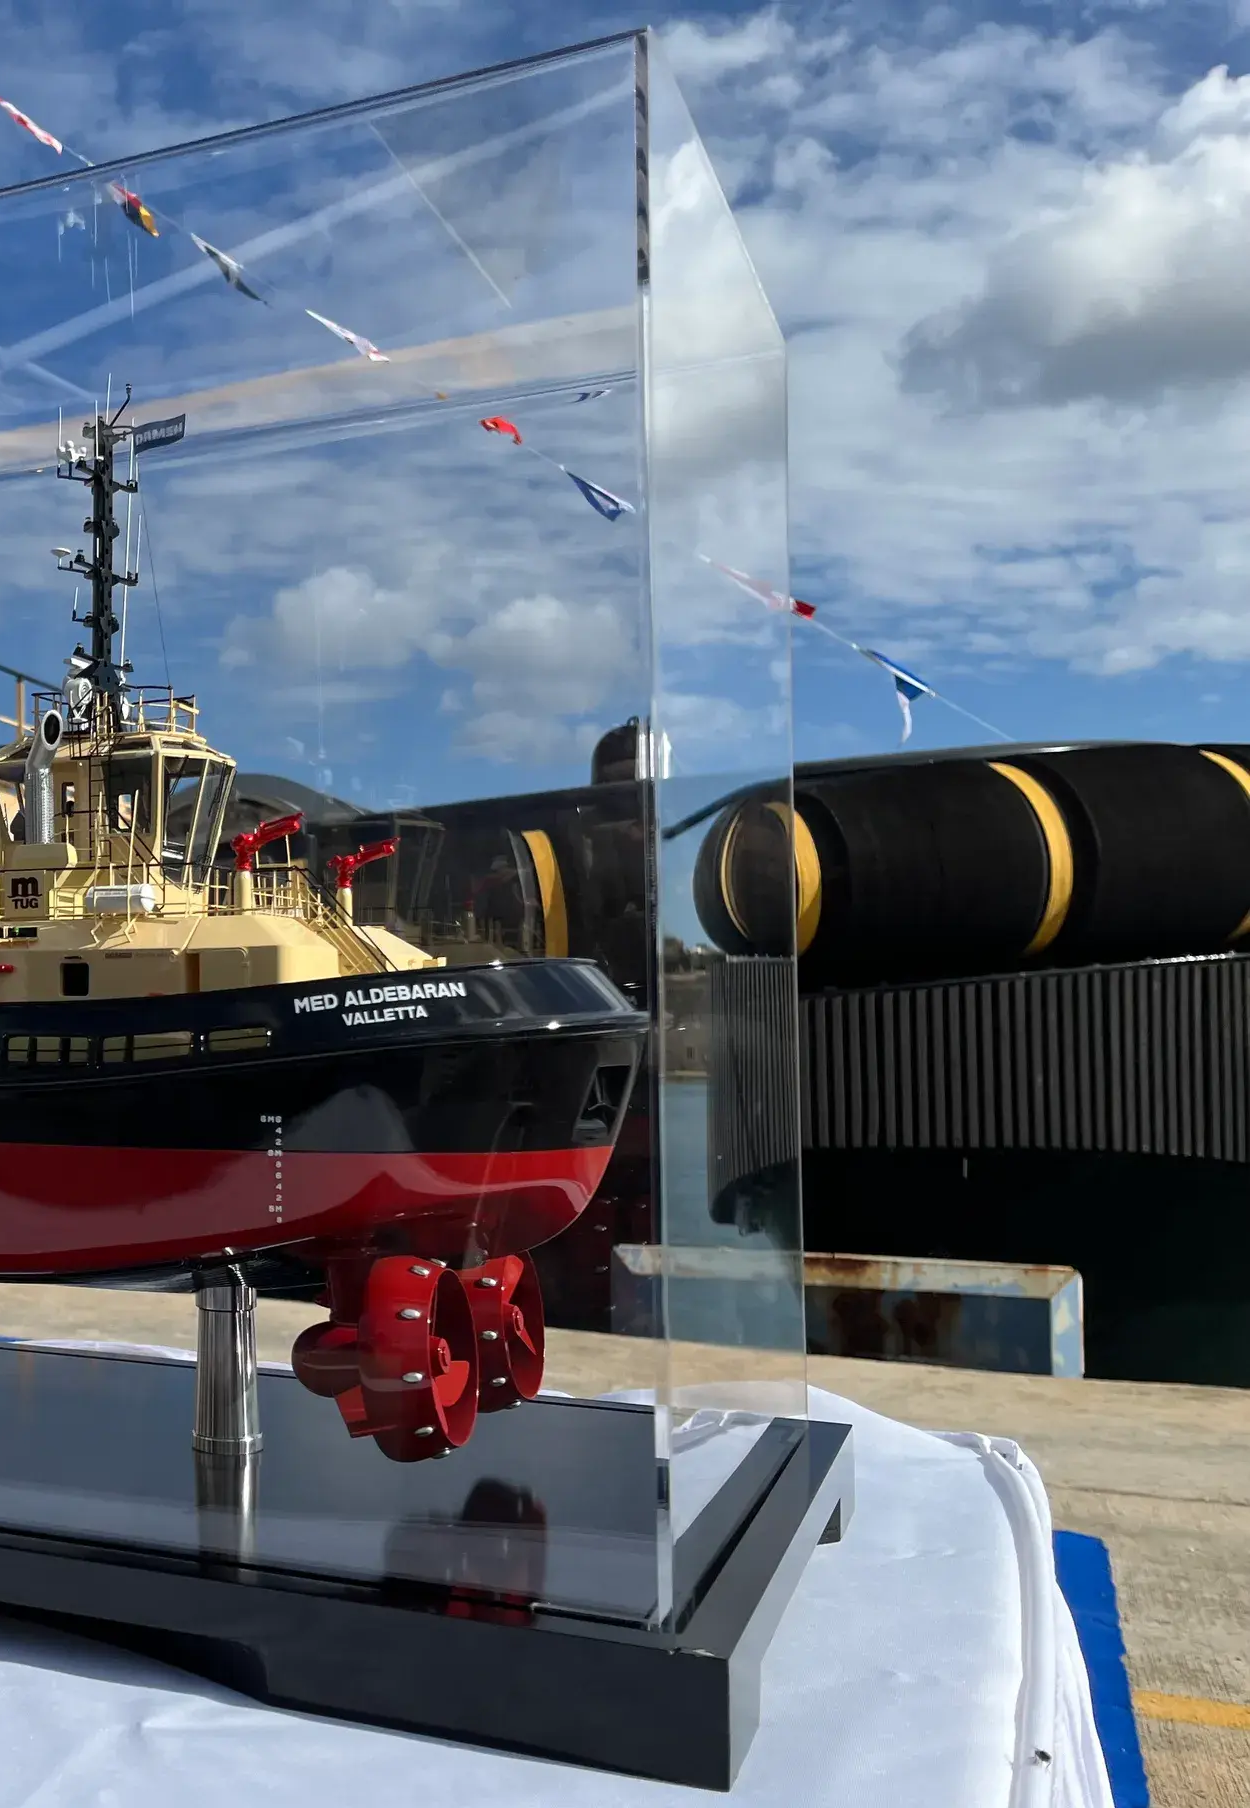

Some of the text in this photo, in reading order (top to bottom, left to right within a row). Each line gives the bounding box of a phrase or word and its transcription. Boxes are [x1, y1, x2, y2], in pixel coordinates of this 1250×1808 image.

[135, 422, 183, 446] DAMEN
[12, 898, 39, 910] TUG
[293, 982, 467, 1014] MED ALDEBARAN
[342, 1005, 428, 1026] VALLETTA
[275, 1138, 282, 1146] 2
[275, 1194, 282, 1202] 2
[268, 1205, 282, 1213] 5M
